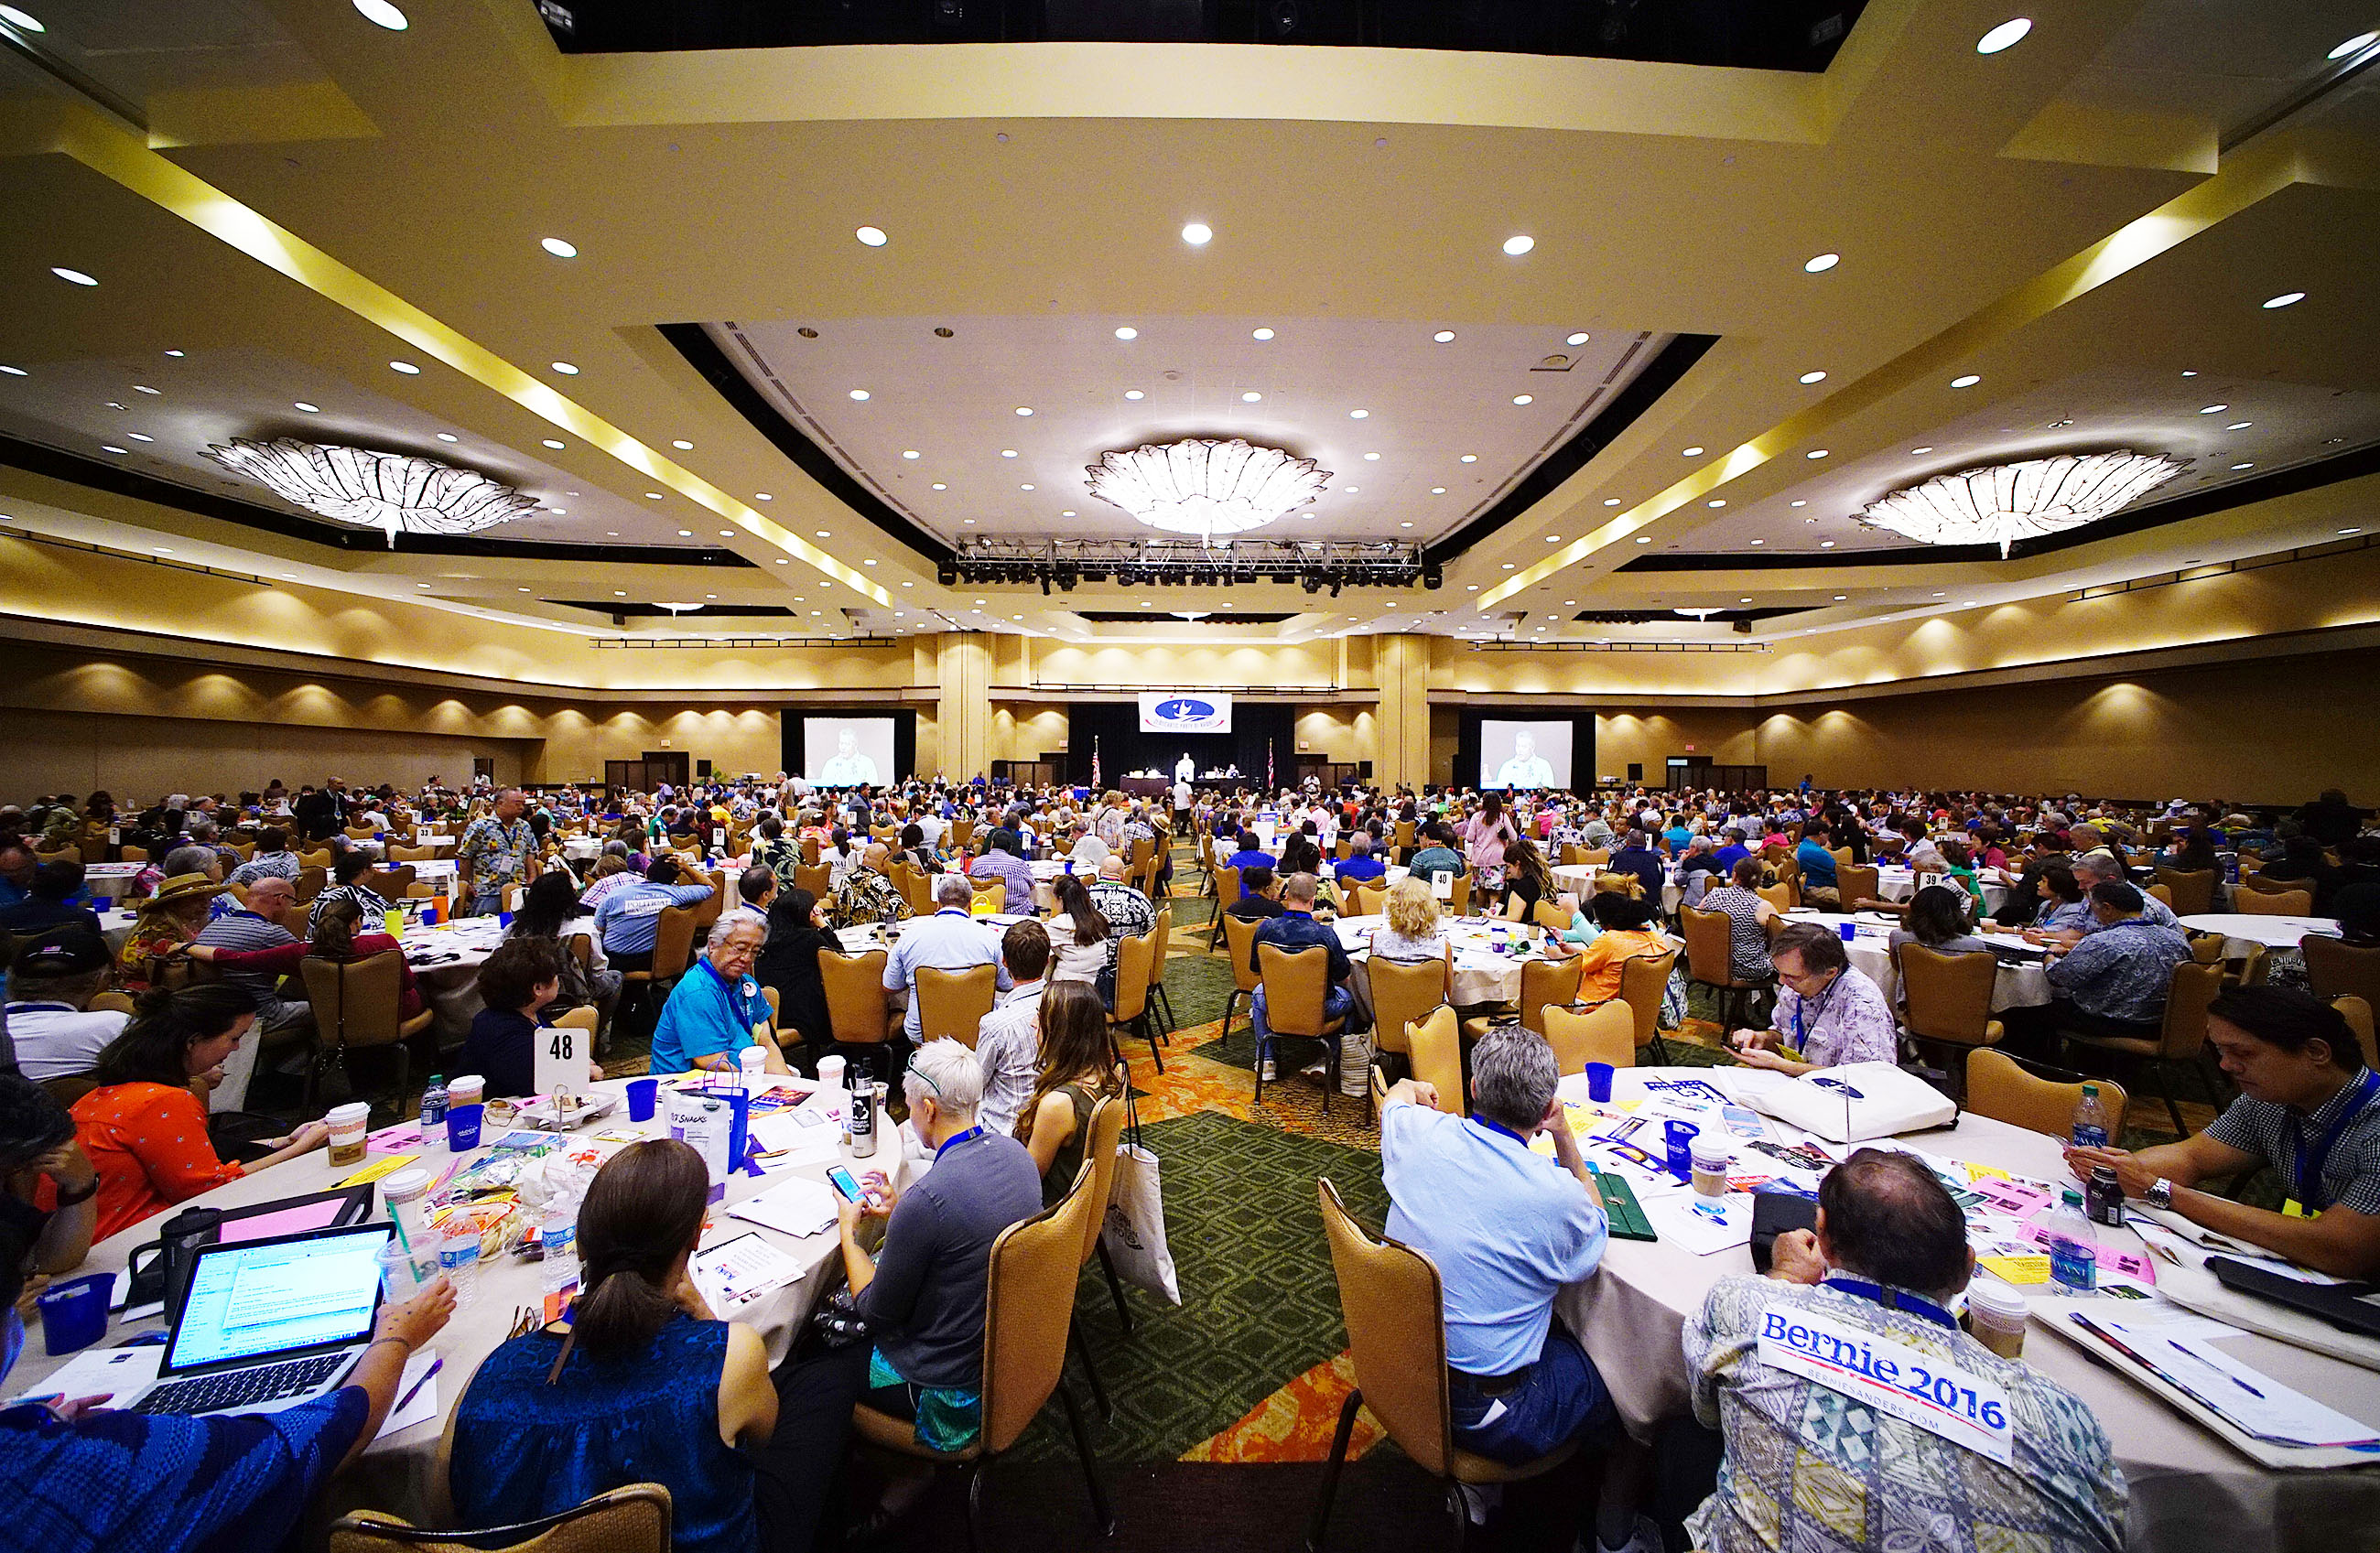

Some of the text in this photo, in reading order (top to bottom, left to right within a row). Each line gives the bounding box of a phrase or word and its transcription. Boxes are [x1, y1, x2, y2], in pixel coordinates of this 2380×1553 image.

[1438, 874, 1447, 884] 40
[1926, 875, 1936, 885] 39
[549, 1034, 573, 1060] 48
[1761, 1312, 2007, 1430] Bernie 2016
[1807, 1368, 1940, 1430] BERNIESANDERS.COM
